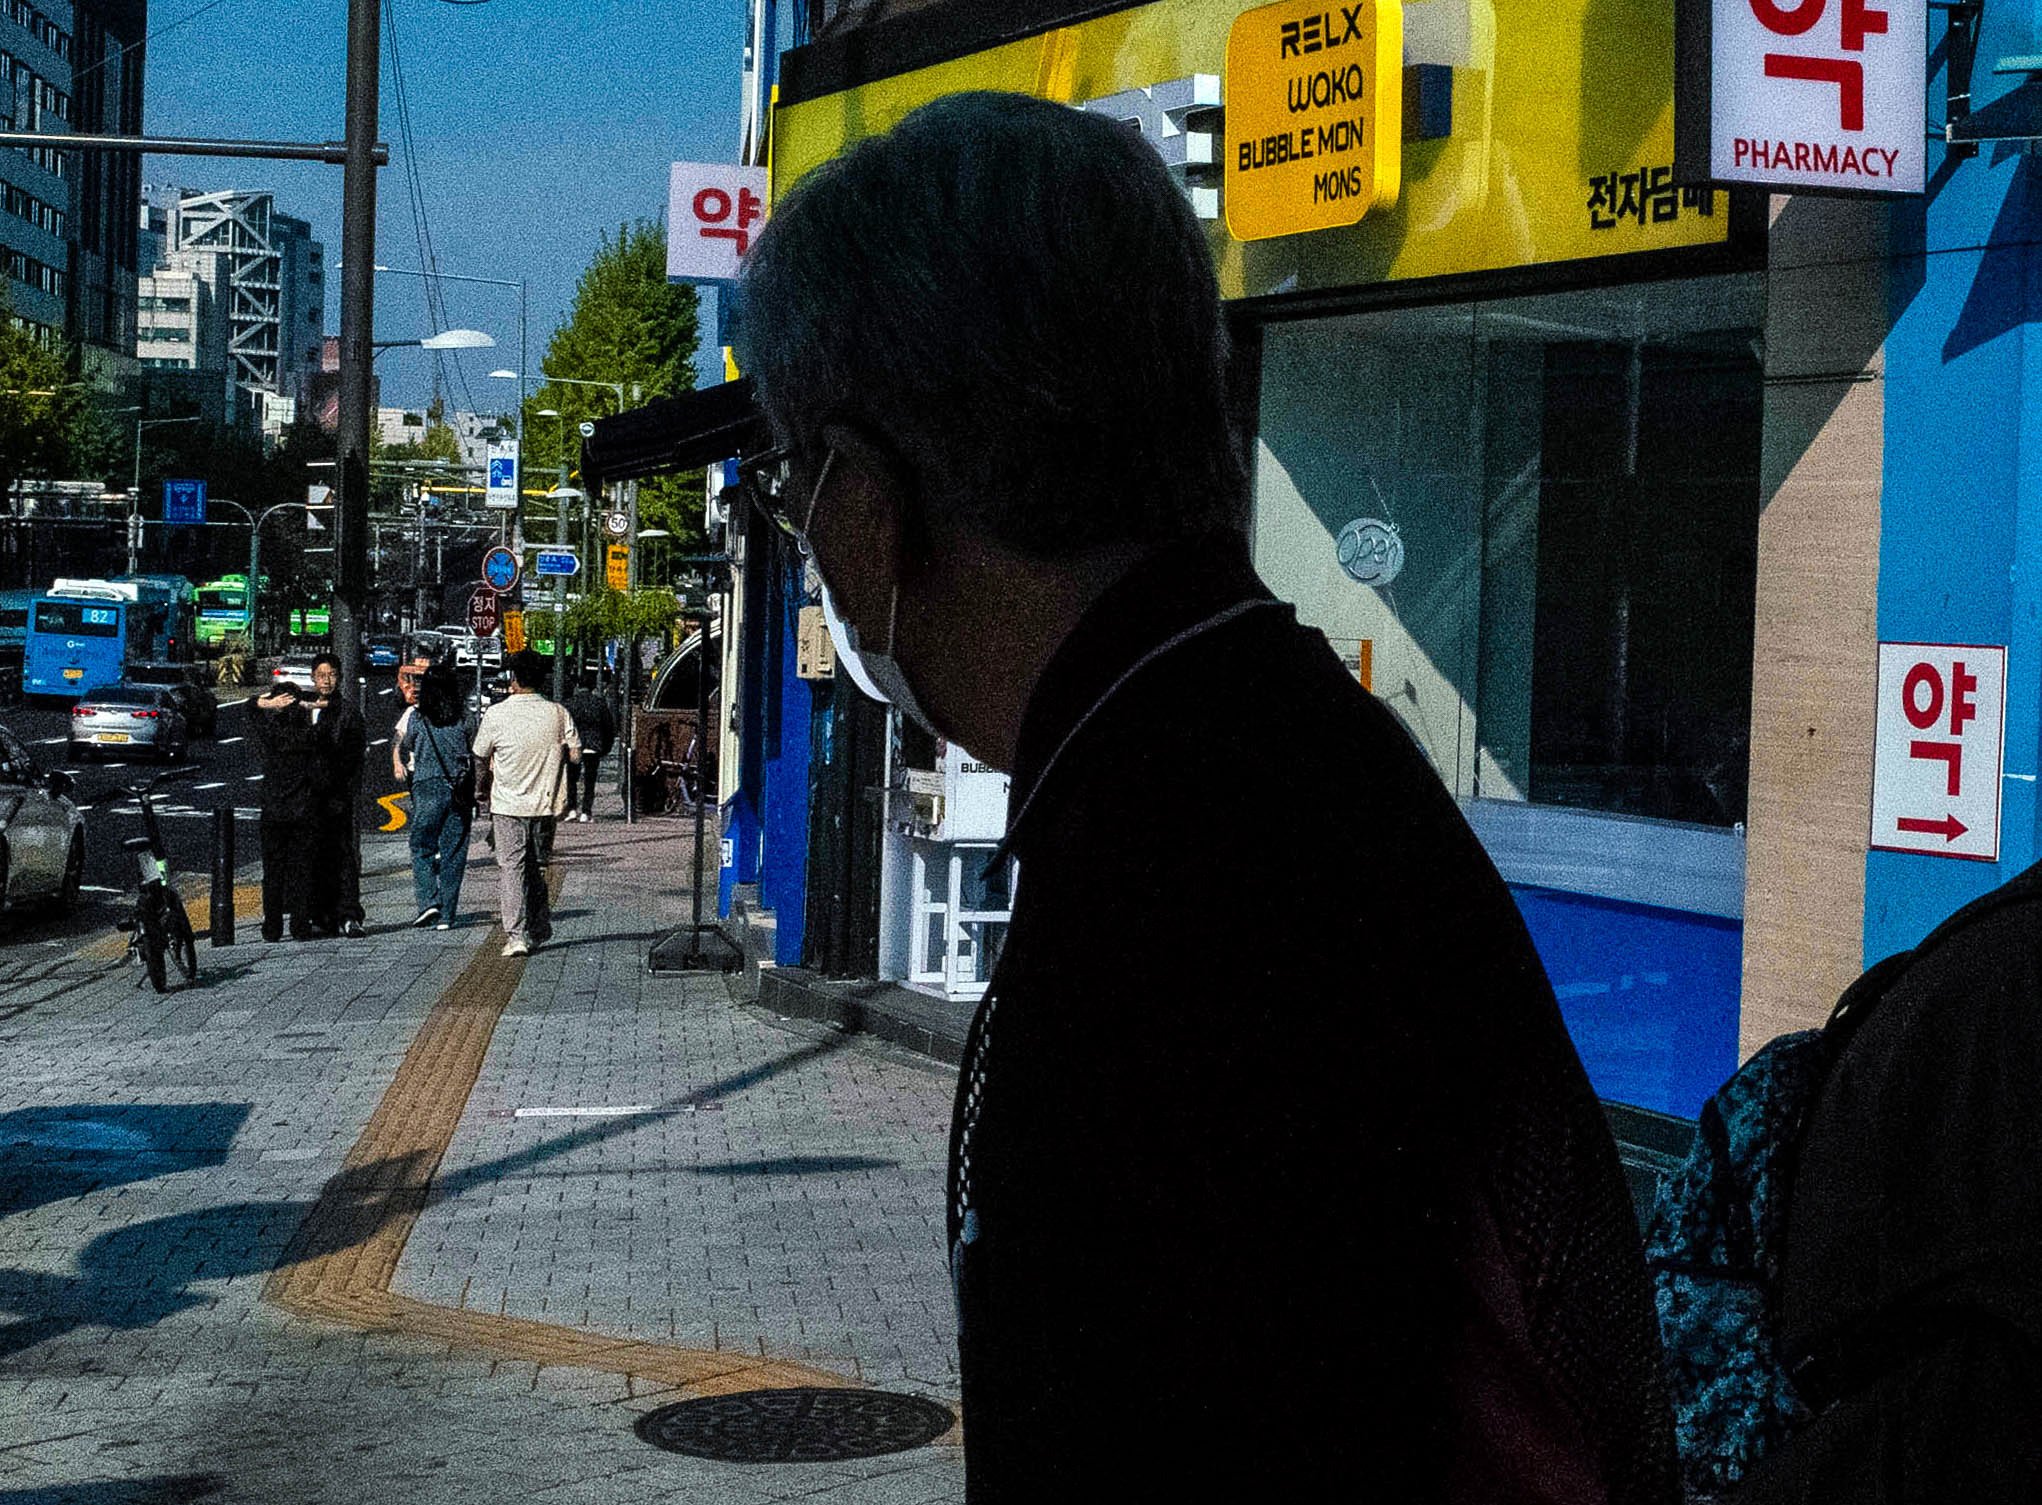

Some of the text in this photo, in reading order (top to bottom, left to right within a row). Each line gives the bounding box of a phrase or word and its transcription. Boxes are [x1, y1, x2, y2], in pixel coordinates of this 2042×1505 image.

[1280, 3, 1363, 59] RELX
[1750, 0, 1889, 132] 약
[1238, 116, 1364, 172] BUBBLE MON
[1733, 138, 1899, 177] PHARMACY
[1313, 166, 1361, 204] MONS
[692, 187, 760, 257] 약
[611, 519, 626, 529] 50
[90, 609, 108, 623] 82
[472, 616, 495, 630] STOP
[473, 596, 496, 613] 정지
[1902, 661, 1977, 796] 약
